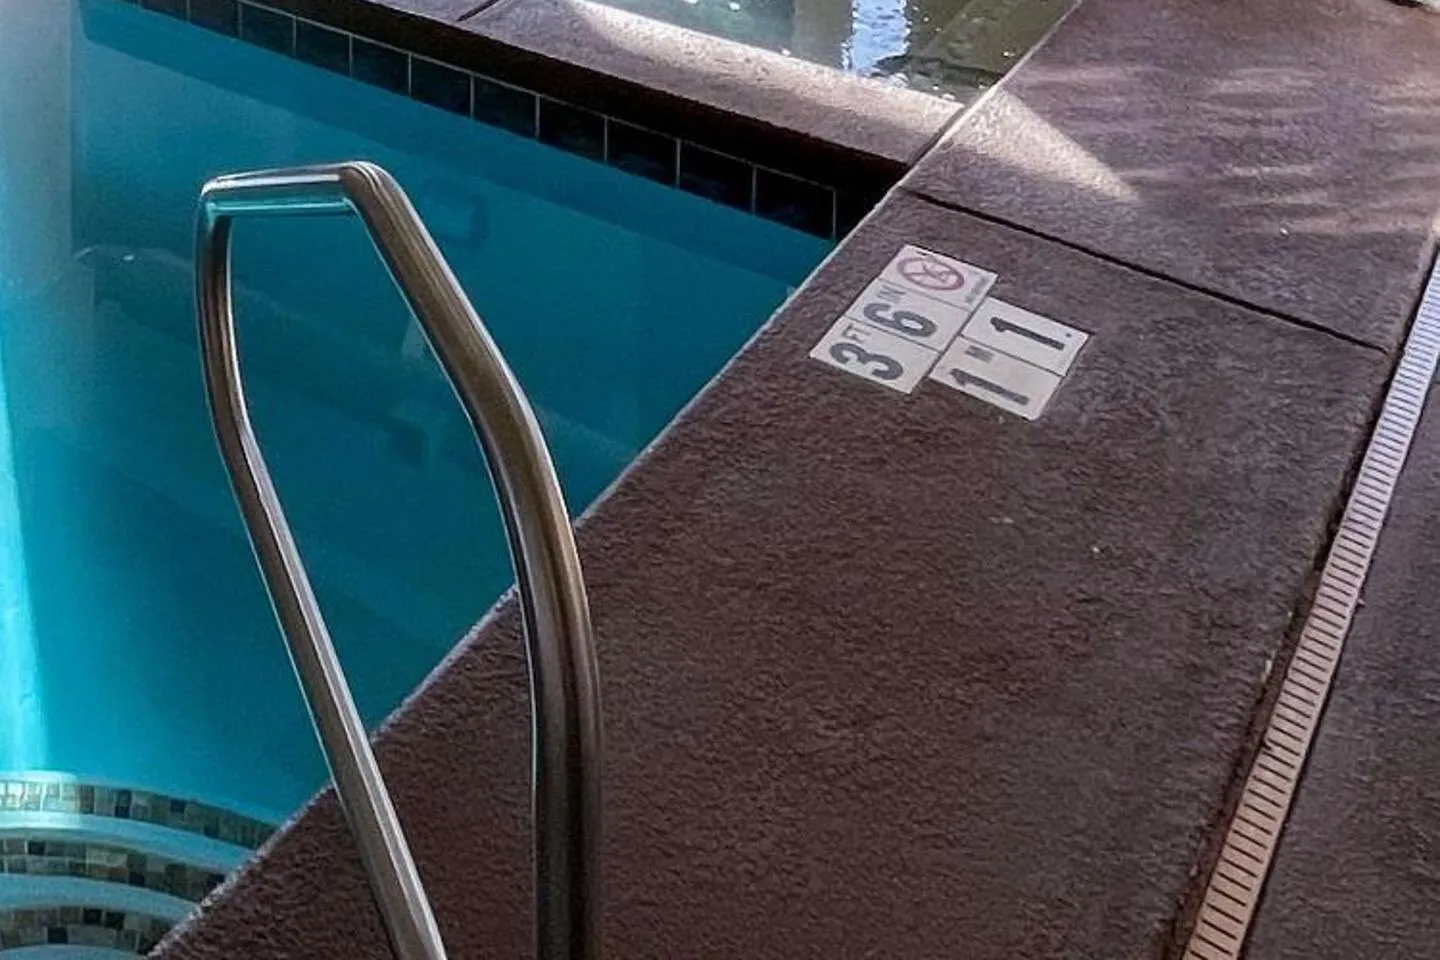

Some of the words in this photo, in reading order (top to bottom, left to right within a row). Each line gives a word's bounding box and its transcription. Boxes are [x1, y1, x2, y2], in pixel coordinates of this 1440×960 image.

[875, 283, 907, 302] IN
[840, 322, 874, 341] FT
[862, 302, 938, 338] 6
[828, 341, 904, 381] 3
[949, 367, 1031, 406] 1
